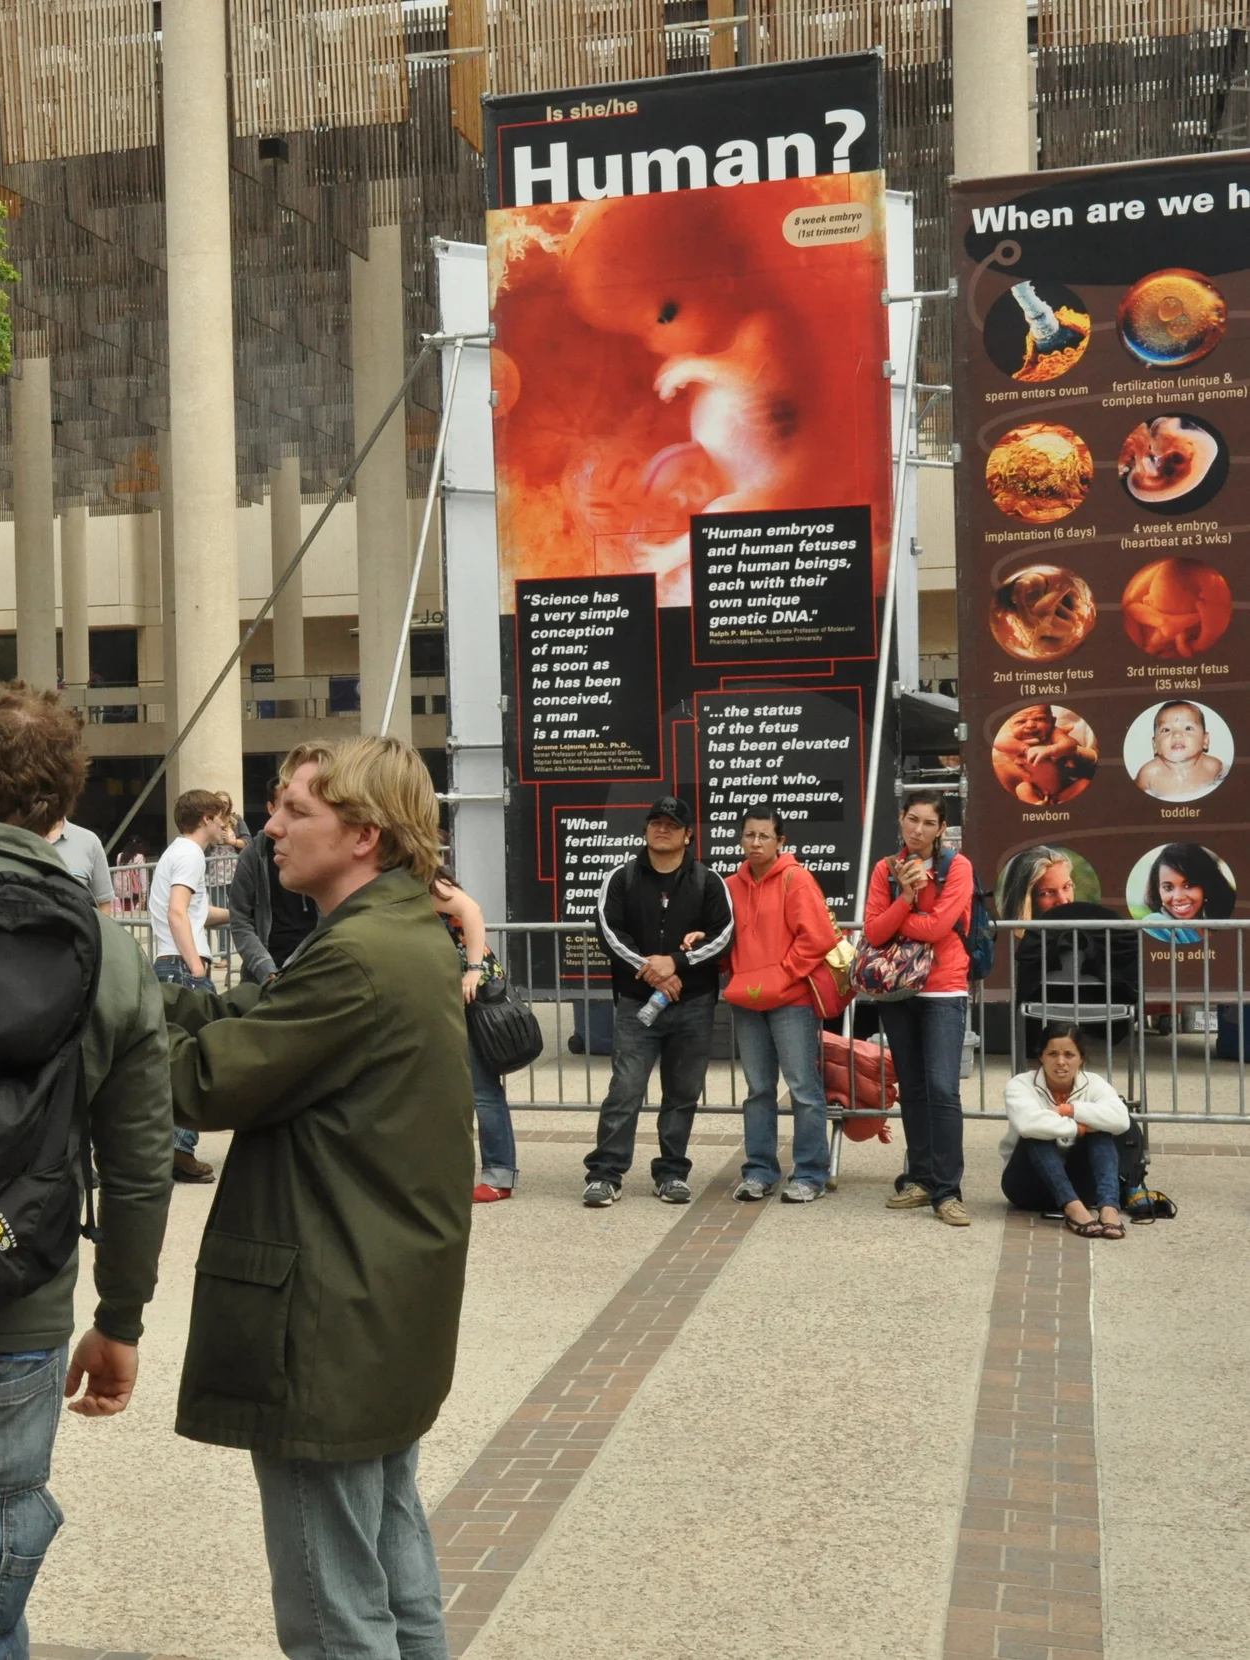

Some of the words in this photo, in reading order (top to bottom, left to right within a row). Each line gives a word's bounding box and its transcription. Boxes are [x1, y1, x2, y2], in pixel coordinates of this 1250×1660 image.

[546, 106, 564, 122] Is
[570, 98, 638, 120] she/he
[513, 109, 866, 207] Human?
[794, 217, 801, 226] 8
[803, 214, 827, 226] week
[829, 211, 862, 225] embryo
[972, 205, 1073, 234] When
[1086, 199, 1146, 223] are
[1158, 192, 1214, 216] we
[797, 227, 813, 239] (1st
[816, 223, 860, 237] trimester)
[1112, 379, 1175, 392] fertilization
[1177, 375, 1220, 389] (unique
[1223, 373, 1233, 384] &
[985, 391, 1019, 402] sperm
[1021, 388, 1056, 400] enters
[1058, 386, 1089, 397] ovum
[1102, 394, 1154, 408] complete
[1156, 392, 1195, 404] human
[1198, 387, 1248, 402] genome)
[702, 525, 761, 540] "Human
[766, 522, 834, 538] embryos
[985, 530, 1051, 543] implantation
[1054, 528, 1065, 540] (6
[1067, 526, 1096, 539] days)
[1133, 524, 1140, 533] 4
[1142, 522, 1173, 533] week
[1175, 521, 1218, 532] embryo
[707, 542, 736, 557] and
[741, 540, 794, 555] human
[798, 538, 856, 552] fetuses
[1121, 536, 1179, 549] (heartbeat
[1182, 536, 1193, 546] at
[1195, 535, 1202, 545] 3
[1204, 533, 1232, 545] wks)
[708, 562, 732, 574] are
[737, 558, 790, 572] human
[794, 556, 852, 572] beings,
[708, 577, 745, 591] each
[750, 576, 786, 589] with
[790, 574, 827, 588] their
[523, 593, 589, 606] “Science
[592, 591, 619, 604] has
[709, 596, 742, 609] own
[747, 594, 800, 610] unique
[421, 609, 443, 624] Jo
[530, 612, 540, 622] a
[543, 610, 576, 625] very
[579, 606, 629, 623] simple
[709, 612, 767, 628] genetic
[772, 610, 818, 624] DNA."
[531, 624, 614, 641] conception
[531, 643, 548, 656] of
[551, 643, 589, 656] man;
[532, 661, 549, 672] as
[552, 660, 589, 672] soon
[592, 659, 610, 670] as
[1127, 666, 1145, 677] 3rd
[1147, 665, 1198, 677] trimester
[1200, 664, 1229, 674] fetus
[532, 676, 551, 690] he
[554, 676, 581, 689] has
[584, 675, 621, 688] been
[993, 672, 1013, 682] 2nd
[1015, 670, 1064, 681] trimester
[1066, 669, 1094, 679] fetus
[1020, 684, 1036, 696] (18
[1039, 683, 1067, 695] wks.)
[1155, 679, 1172, 690] (35
[1174, 678, 1200, 690] wks)
[533, 692, 613, 707] conceived,
[533, 712, 542, 723] a
[545, 711, 578, 723] man
[753, 704, 802, 717] status
[534, 727, 547, 740] is
[550, 728, 560, 739] a
[563, 726, 610, 739] man.”
[707, 722, 725, 735] of
[728, 722, 754, 734] the
[758, 721, 799, 733] fetus
[708, 739, 735, 752] has
[739, 738, 778, 751] been
[781, 736, 849, 750] elevated
[709, 757, 725, 769] to
[728, 756, 762, 769] that
[765, 756, 784, 768] of
[709, 776, 719, 786] a
[722, 773, 780, 789] patient
[783, 773, 821, 787] who,
[709, 792, 724, 803] in
[729, 792, 768, 805] large
[772, 792, 844, 804] measure,
[710, 811, 737, 821] can
[1022, 811, 1070, 822] newborn
[1161, 807, 1201, 818] toddler
[561, 818, 608, 830] "When
[710, 826, 735, 838] the
[802, 844, 836, 854] care
[565, 852, 578, 864] is
[582, 851, 638, 866] comple
[710, 860, 740, 872] that
[565, 872, 574, 881] a
[566, 888, 601, 900] gene
